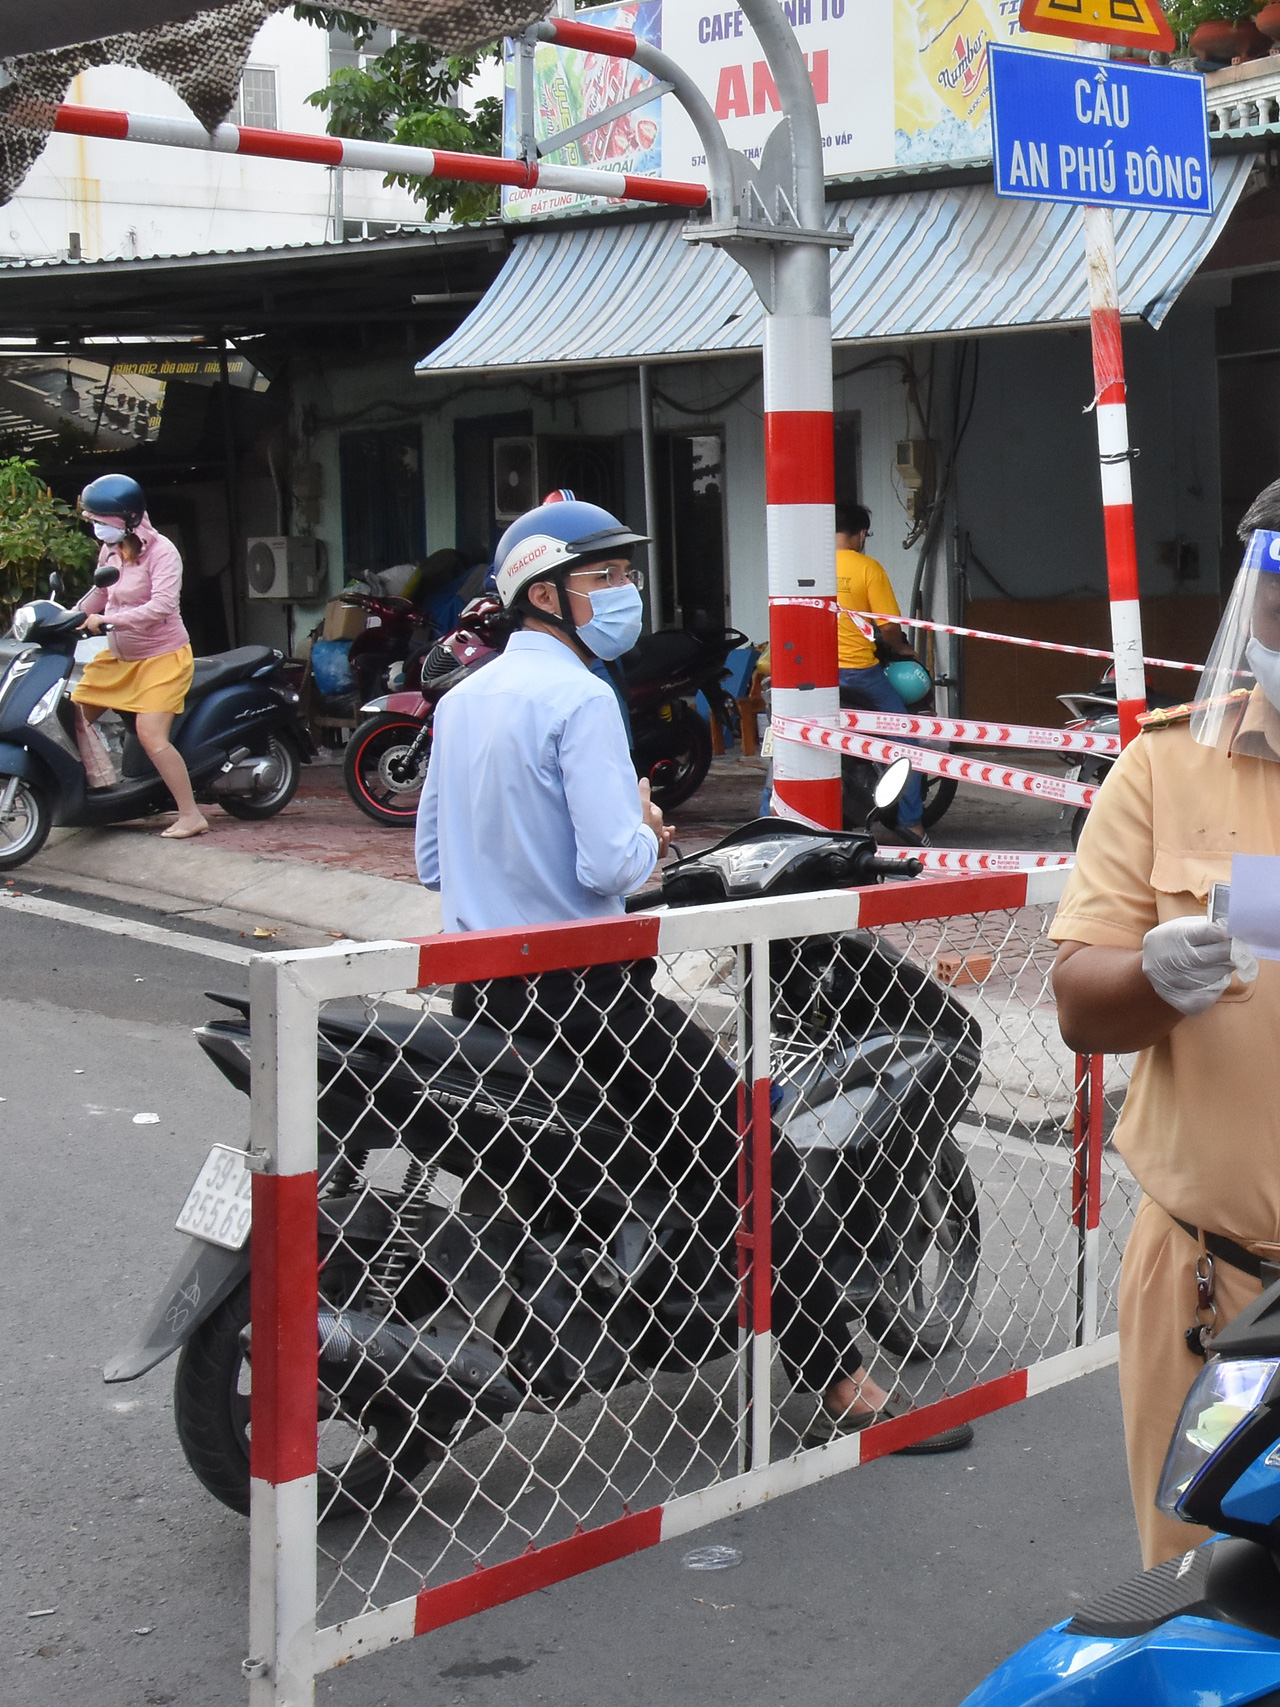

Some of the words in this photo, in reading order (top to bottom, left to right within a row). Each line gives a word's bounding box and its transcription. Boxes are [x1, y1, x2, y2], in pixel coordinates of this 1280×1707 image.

[698, 6, 743, 44] CAFÉ
[1074, 66, 1130, 129] CẦU
[1009, 140, 1050, 189] AN
[1058, 139, 1117, 194] PHÚ
[1125, 145, 1202, 201] ĐÔNG
[506, 544, 548, 578] VISACOOP
[181, 1190, 252, 1244] 355.69
